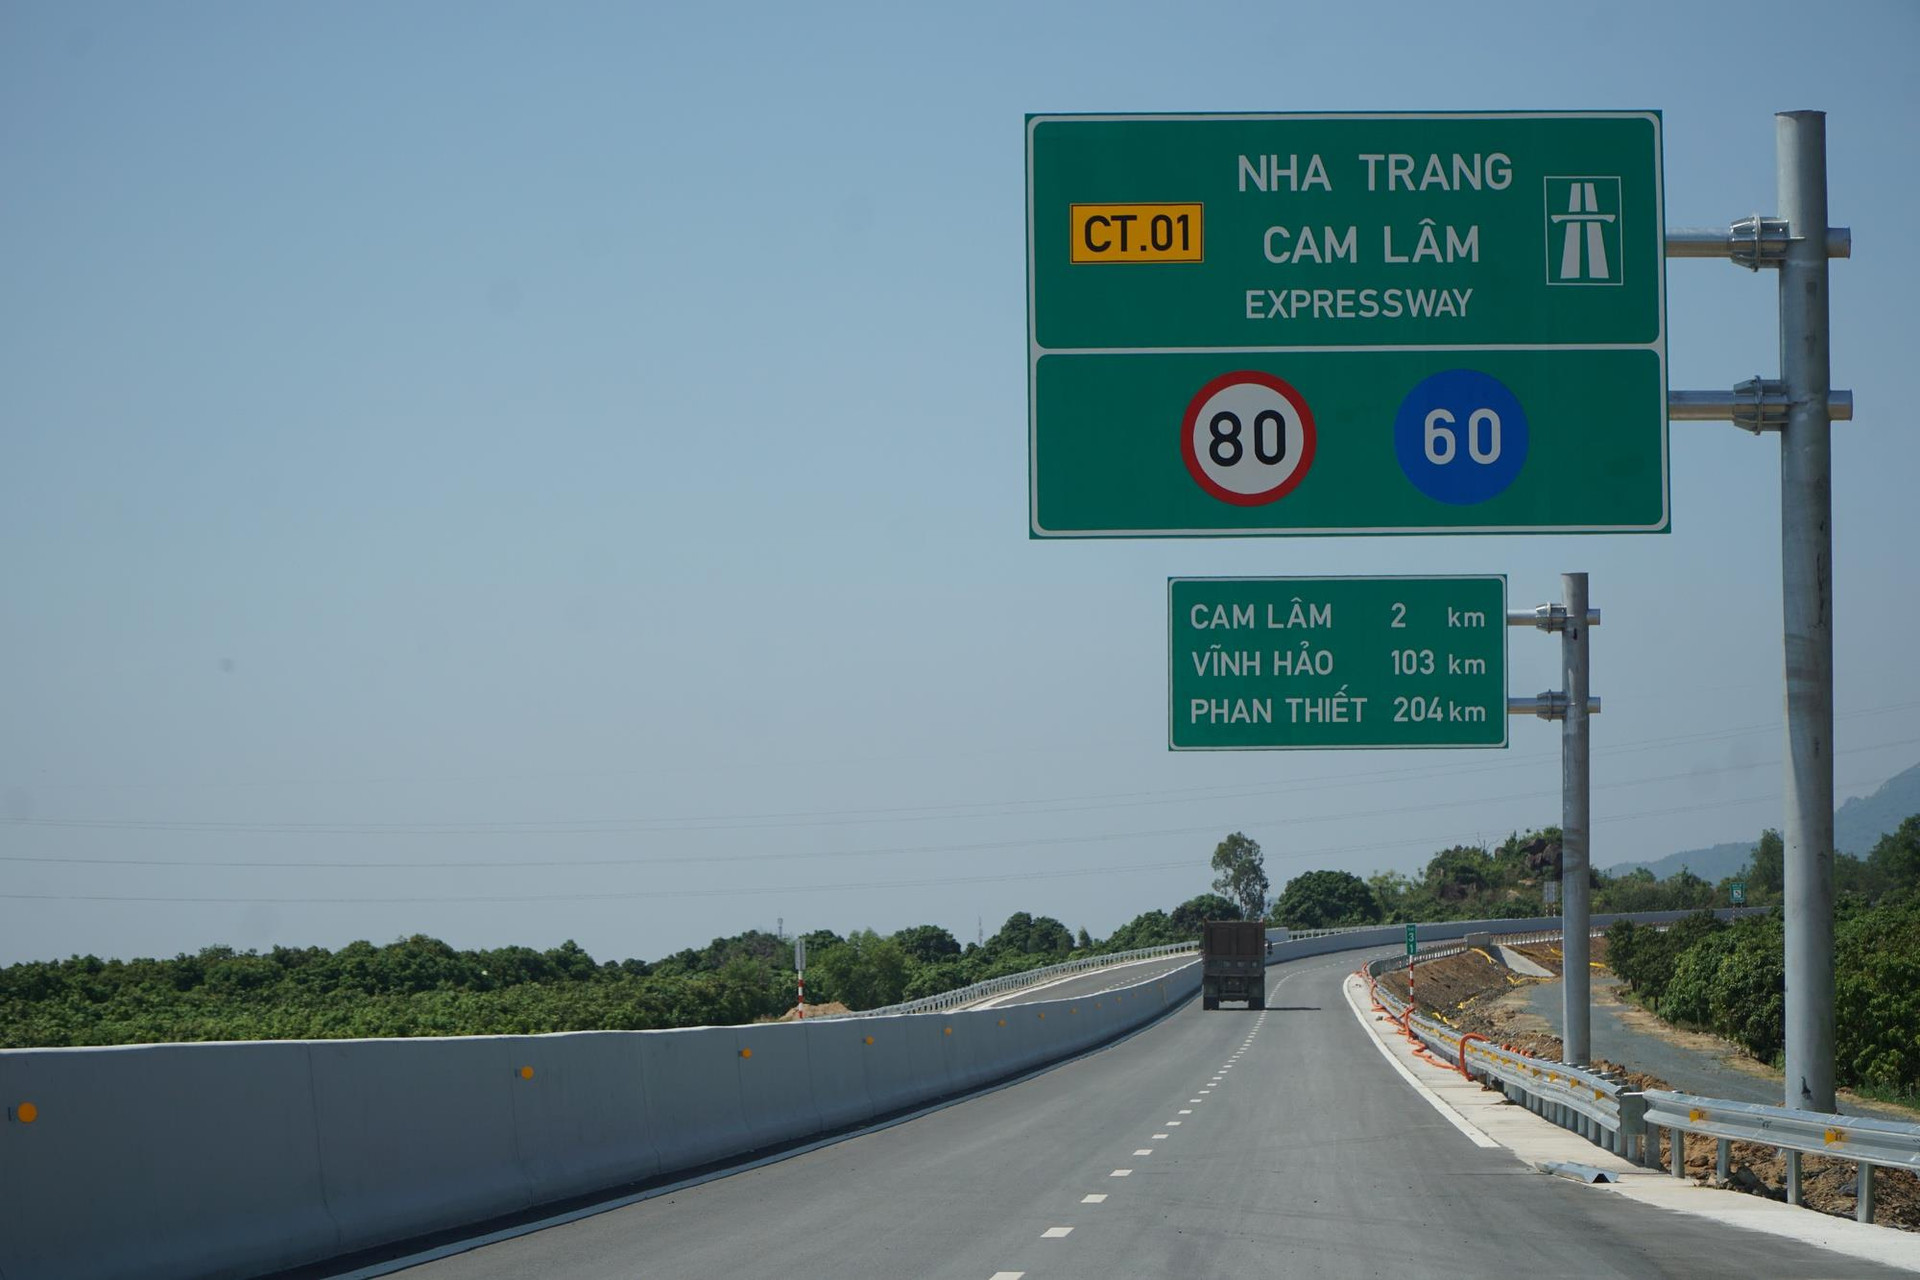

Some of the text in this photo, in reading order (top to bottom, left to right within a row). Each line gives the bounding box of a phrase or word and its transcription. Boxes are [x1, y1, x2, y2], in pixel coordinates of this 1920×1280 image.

[1238, 152, 1513, 192] NHA TRANG
[1083, 213, 1192, 253] CT.01
[1263, 217, 1480, 264] CAM LÂM
[1245, 288, 1473, 319] EXPRESSWAY
[1209, 409, 1287, 467] 80
[1424, 408, 1501, 465] 60
[1190, 597, 1485, 629] CAM LÂM 2 km
[1191, 641, 1486, 676] VĨNH HẢO 103 km
[1190, 684, 1486, 724] PHAN THIẾT 204 km
